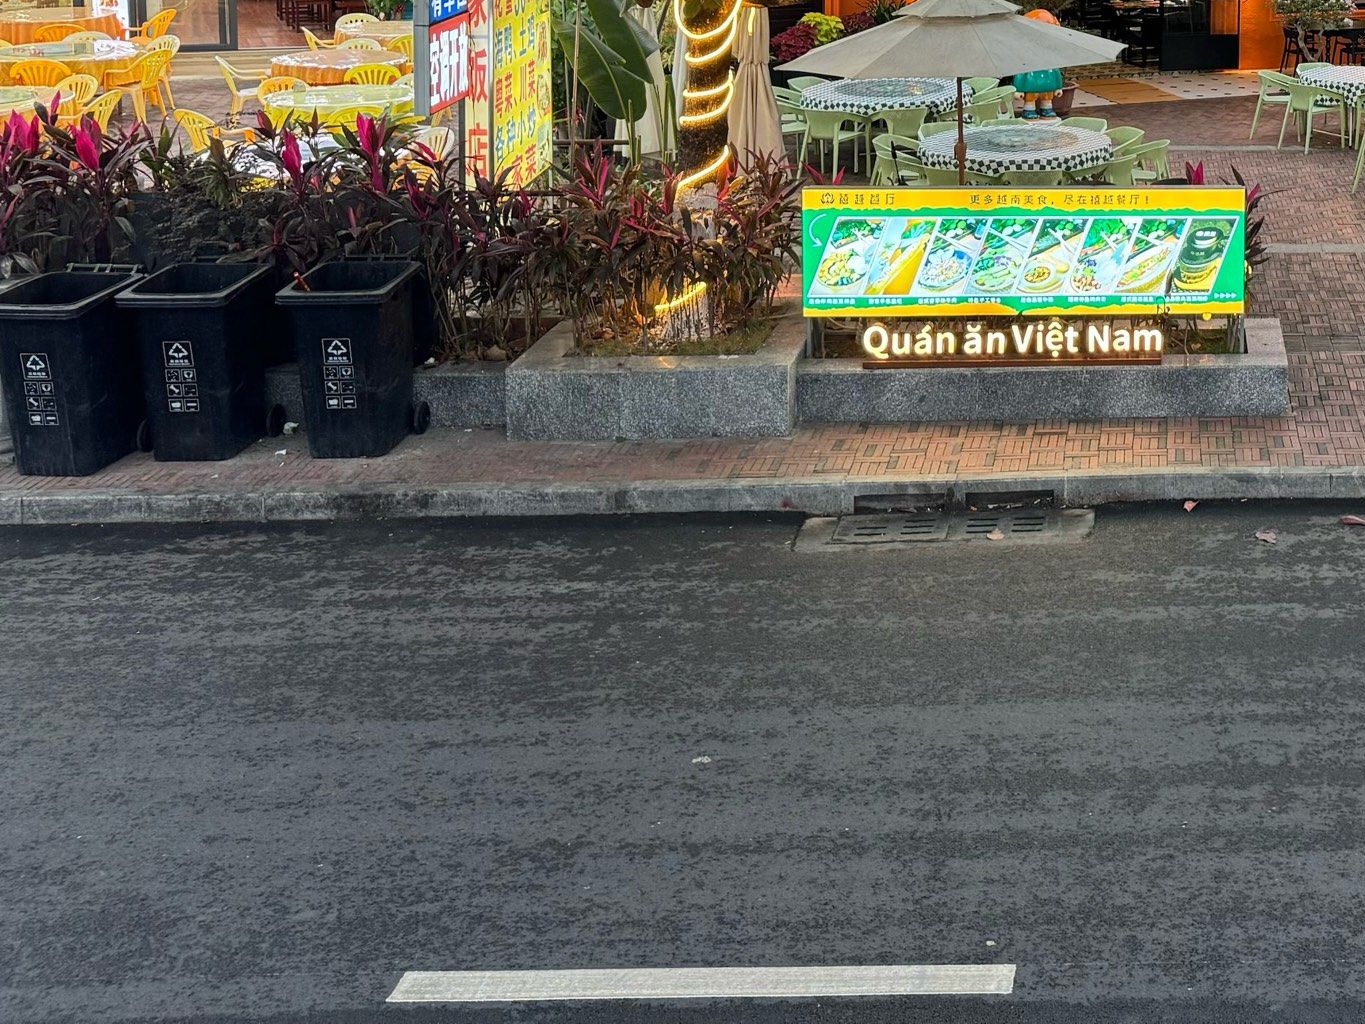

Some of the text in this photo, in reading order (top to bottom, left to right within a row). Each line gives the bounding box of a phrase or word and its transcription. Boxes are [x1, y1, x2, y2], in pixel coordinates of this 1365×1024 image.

[430, 22, 469, 108] 空调开放
[495, 59, 536, 119] 粤菜、川菜
[495, 103, 537, 161] 各种小炒
[862, 323, 1163, 359] Quán ăn Việt Nam
